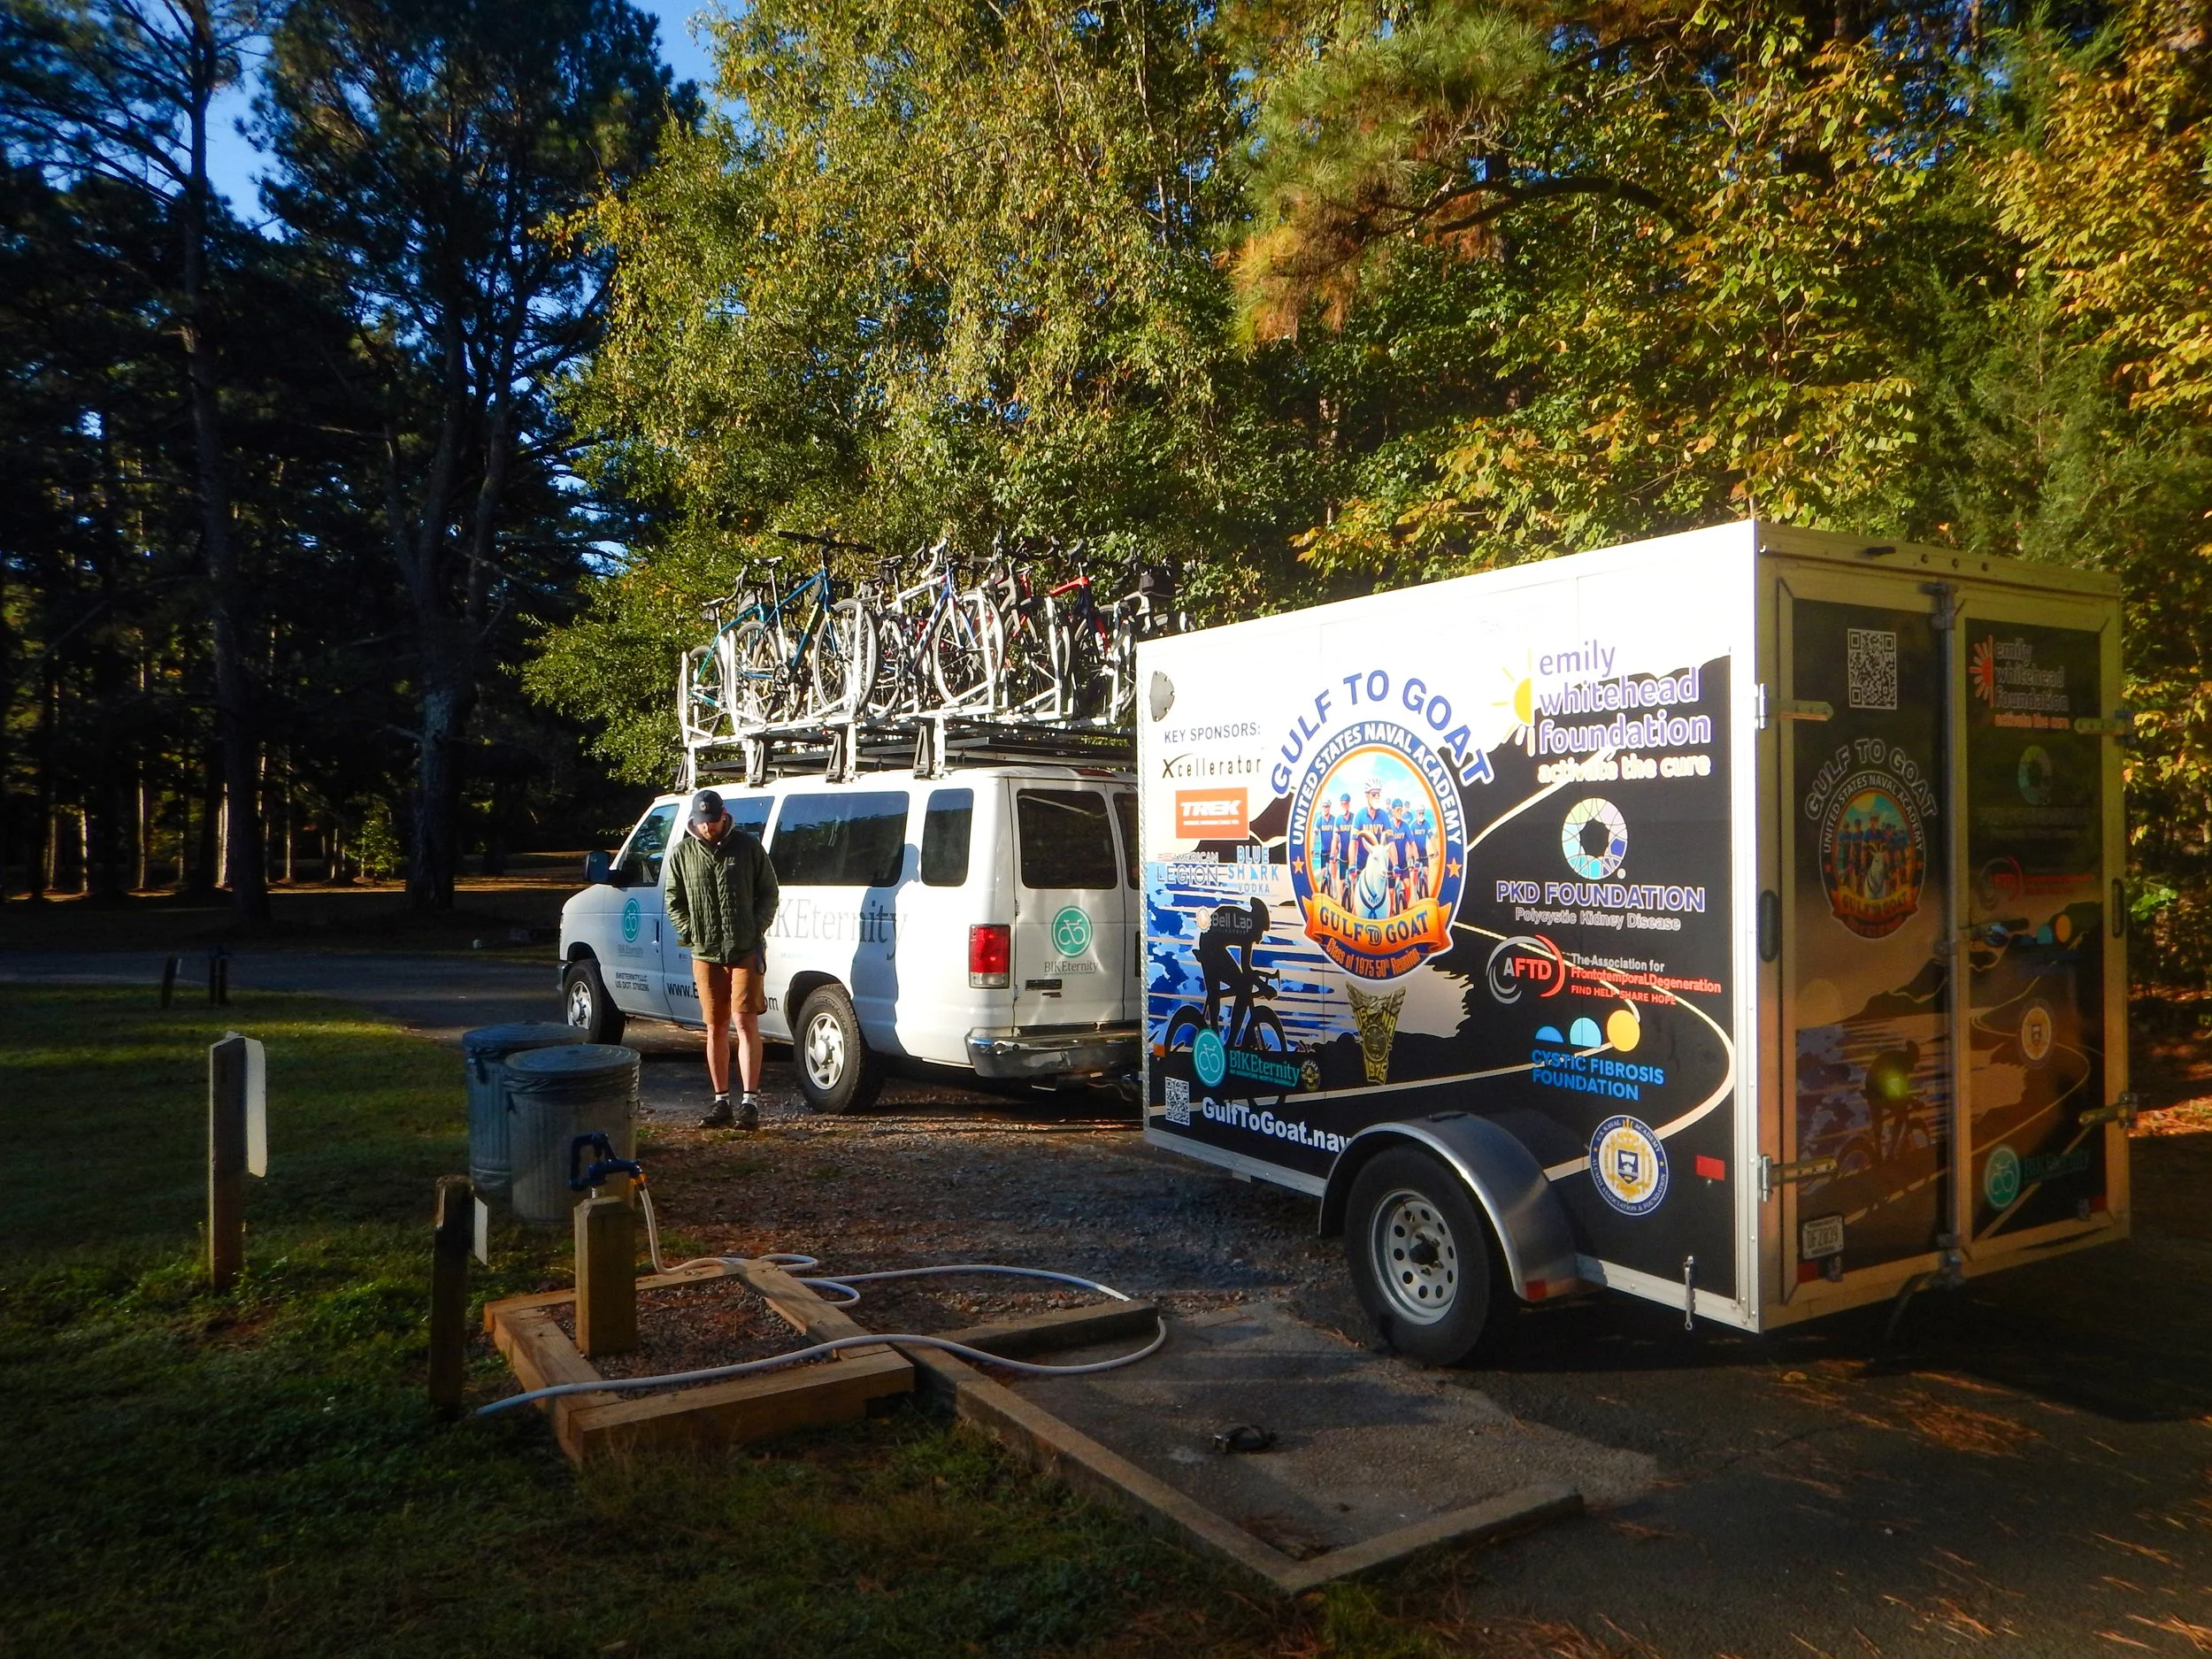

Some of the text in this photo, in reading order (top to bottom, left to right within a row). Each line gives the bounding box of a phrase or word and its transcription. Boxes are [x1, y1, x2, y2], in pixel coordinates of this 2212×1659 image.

[1540, 640, 1615, 677] emily
[1994, 638, 2032, 666] emily
[1540, 667, 1700, 715] whitehead
[1164, 722, 1261, 743] KEY SPONSORS:
[1271, 670, 1492, 795] GULF TO GOAT
[1540, 709, 1711, 756] foundation
[1162, 753, 1262, 779] Xcellerator
[1538, 754, 1711, 783] activate the cure
[1805, 738, 1939, 820] GULF TO GOAT
[1293, 723, 1463, 845] UNITED STATES NAVAL ACADEMY
[1180, 800, 1241, 816] TREK
[1824, 774, 1924, 854] UNITED STATES NAVAL ACADEMY
[1172, 852, 1218, 863] AMERICAN
[1237, 845, 1269, 864] BLUE
[1157, 865, 1218, 886] LEGION
[1228, 864, 1279, 881] SHARK
[1239, 883, 1270, 894] VODKA
[1497, 880, 1705, 912] PKD FOUNDATION
[766, 899, 909, 961] KEternity
[1211, 912, 1253, 933] Bell Lap
[1319, 906, 1429, 945] GULF TO GOAT
[1515, 907, 1681, 931] Polycystic Kidney Disease
[1044, 960, 1098, 973] BIKEternity
[1326, 938, 1345, 964] Class
[1345, 954, 1355, 970] of
[1356, 956, 1374, 977] 1975
[1391, 948, 1421, 975] Reunion
[1503, 958, 1552, 979] AFTD
[1571, 953, 1664, 972] The Association for
[1571, 967, 1722, 993] Frontotemporal Degeneration
[1571, 985, 1677, 1005] FIND HELP SHARE HOPE
[1229, 1050, 1300, 1087] BIKEternity
[1532, 1049, 1664, 1085] CYSTIC FIBROSIS
[1532, 1069, 1639, 1101] FOUNDATION
[1202, 1097, 1351, 1152] GulfToGoat.nav
[1634, 1124, 1661, 1153] ACADEMY
[1643, 1173, 1666, 1210] FOUNDATION
